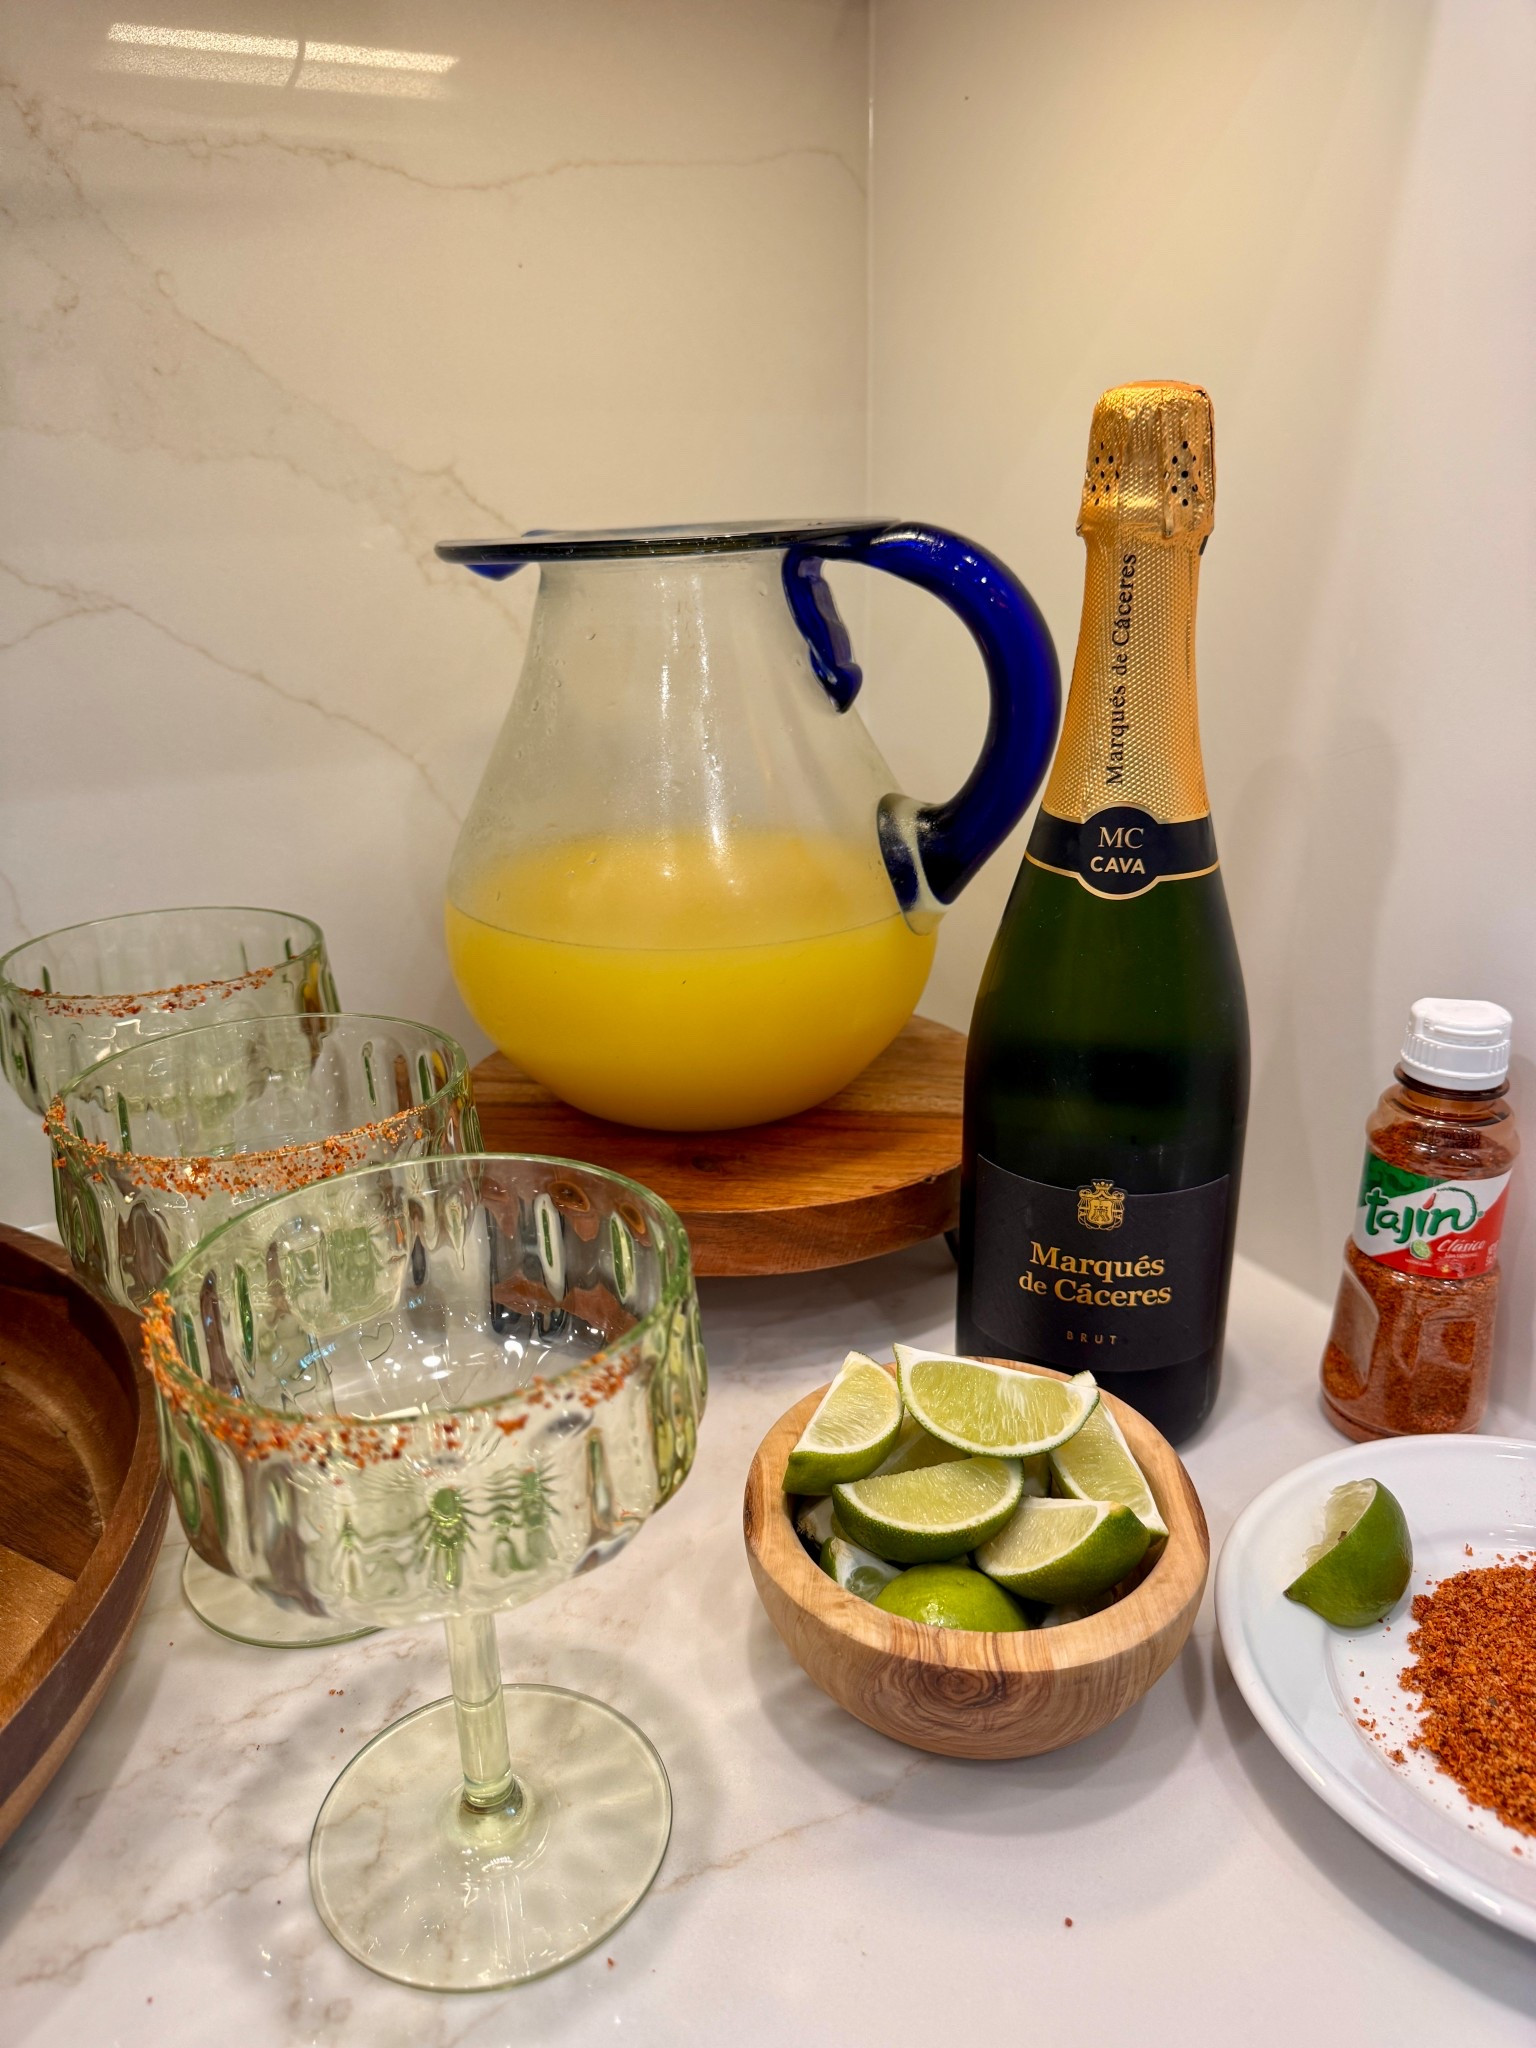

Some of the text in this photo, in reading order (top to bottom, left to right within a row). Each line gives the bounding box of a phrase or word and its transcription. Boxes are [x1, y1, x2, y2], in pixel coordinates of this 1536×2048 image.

[1106, 553, 1137, 785] Marqués de Cáceres
[1098, 827, 1144, 849] MC
[1090, 857, 1146, 875] CAVA
[1029, 1240, 1166, 1284] Marqués
[1018, 1270, 1173, 1308] de Cáceres
[1066, 1330, 1118, 1345] BRUT
